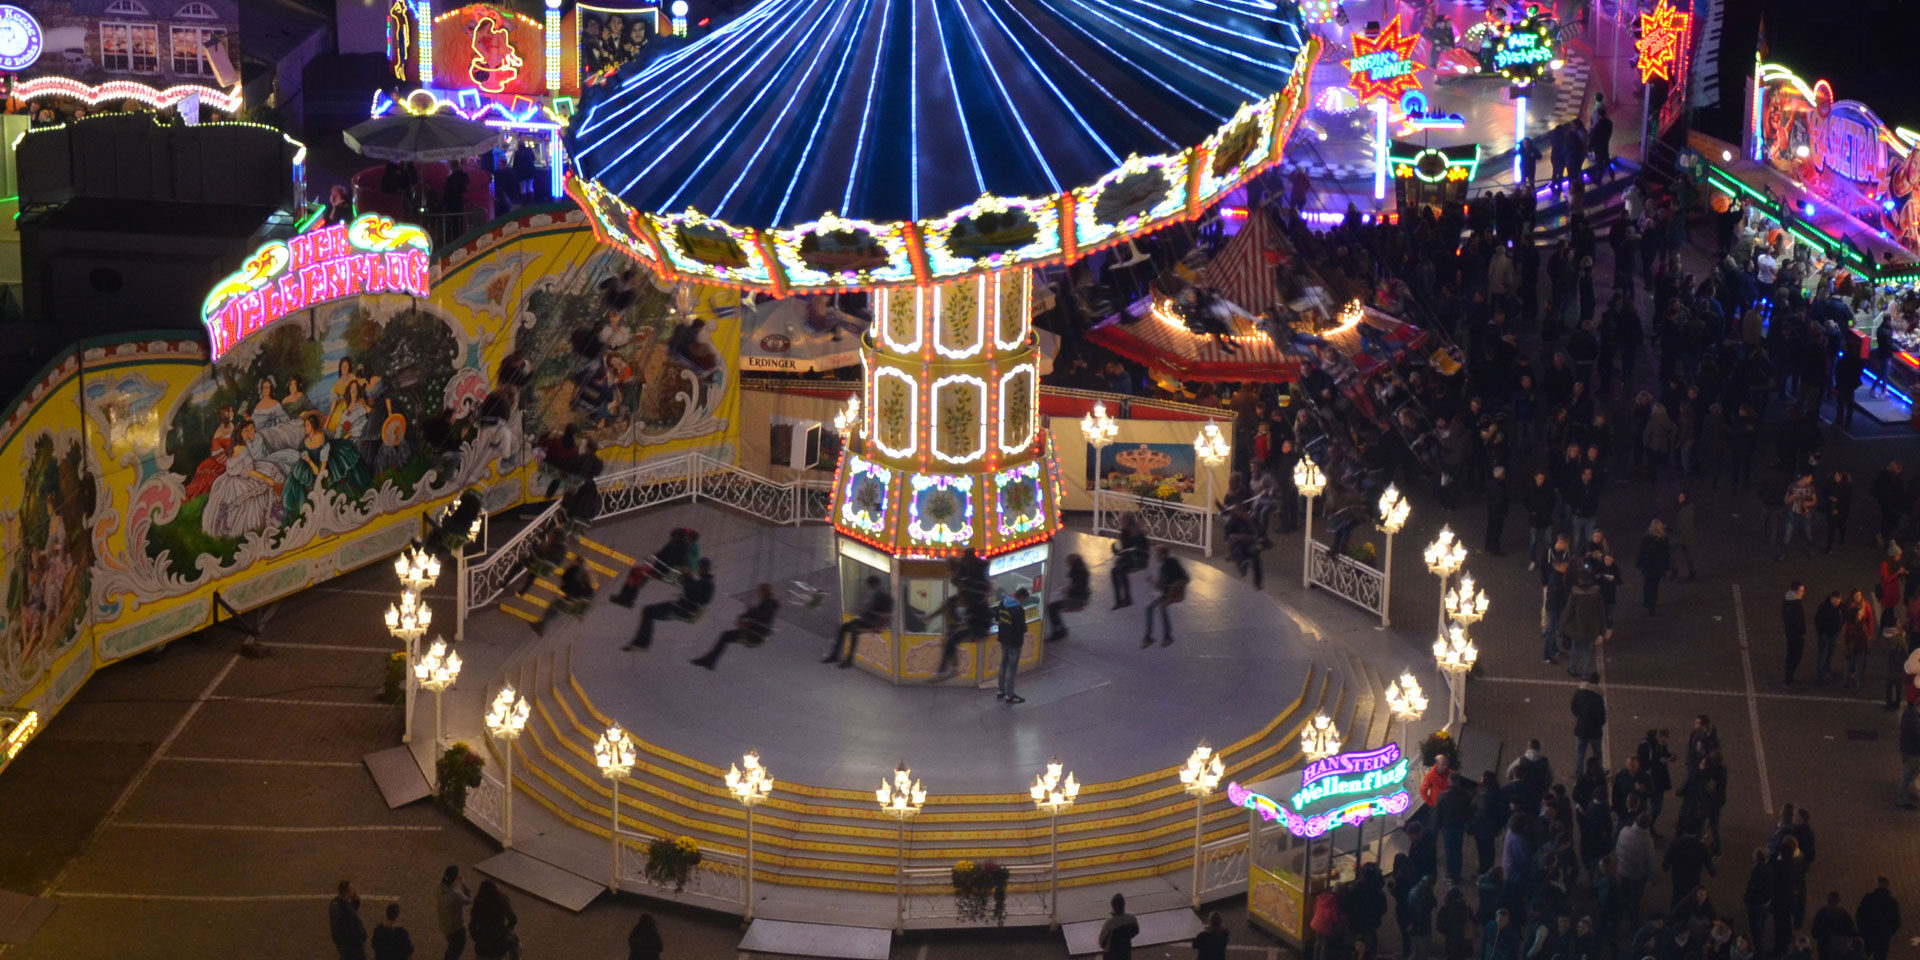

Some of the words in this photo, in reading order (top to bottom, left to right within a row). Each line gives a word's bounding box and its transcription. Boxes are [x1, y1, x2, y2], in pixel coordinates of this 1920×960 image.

[1371, 59, 1411, 80] DANCE
[288, 224, 352, 272] DER
[207, 248, 430, 362] WELLENFLUG
[749, 357, 797, 369] ERDINGER
[1292, 759, 1408, 811] Wellenflug
